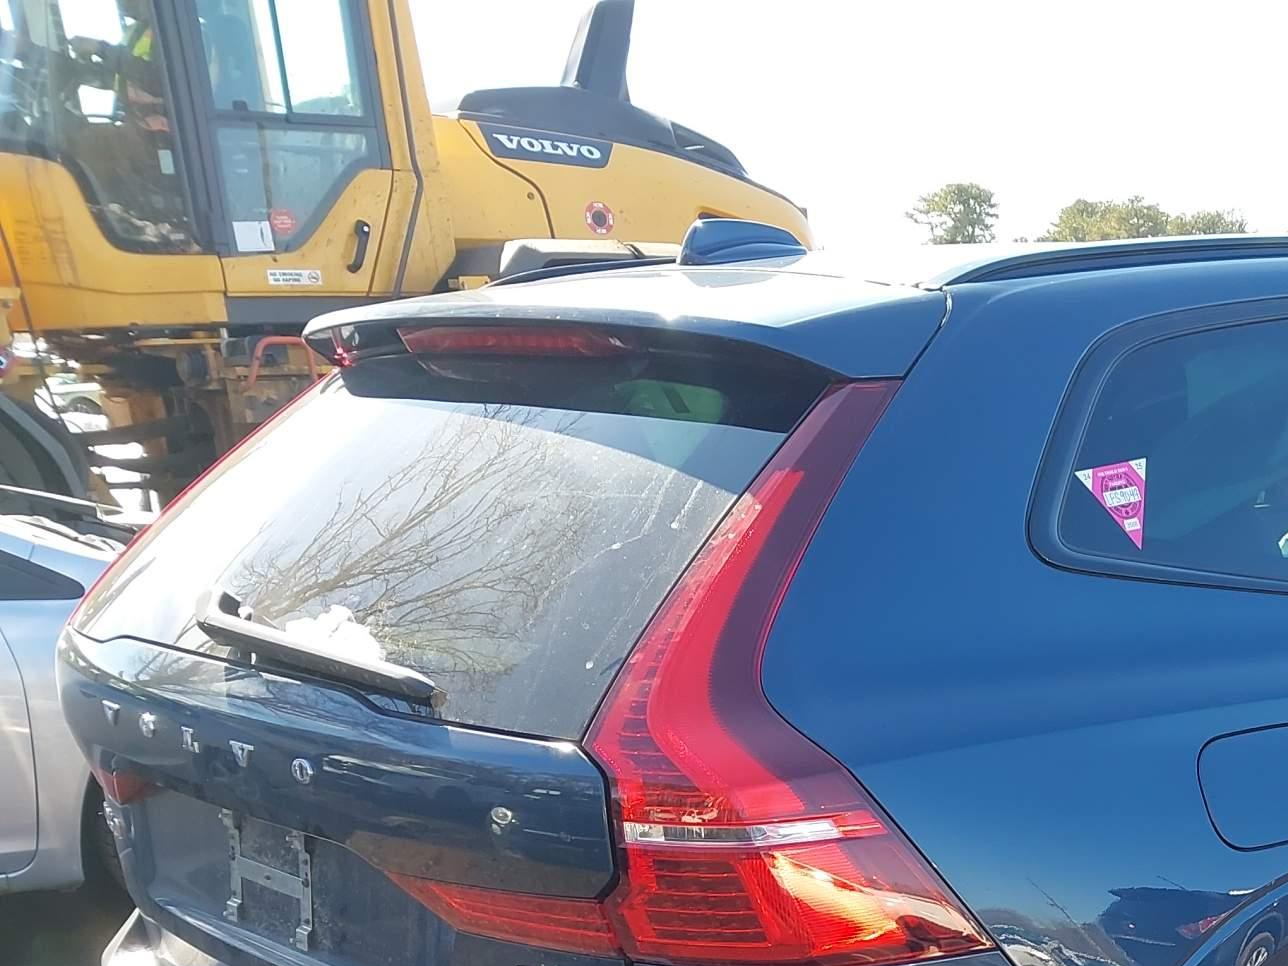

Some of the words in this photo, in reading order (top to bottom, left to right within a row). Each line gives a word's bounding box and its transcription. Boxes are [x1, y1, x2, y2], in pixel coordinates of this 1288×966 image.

[492, 133, 601, 159] VOLVO
[1083, 473, 1091, 481] 24
[102, 699, 314, 785] VOLVO
